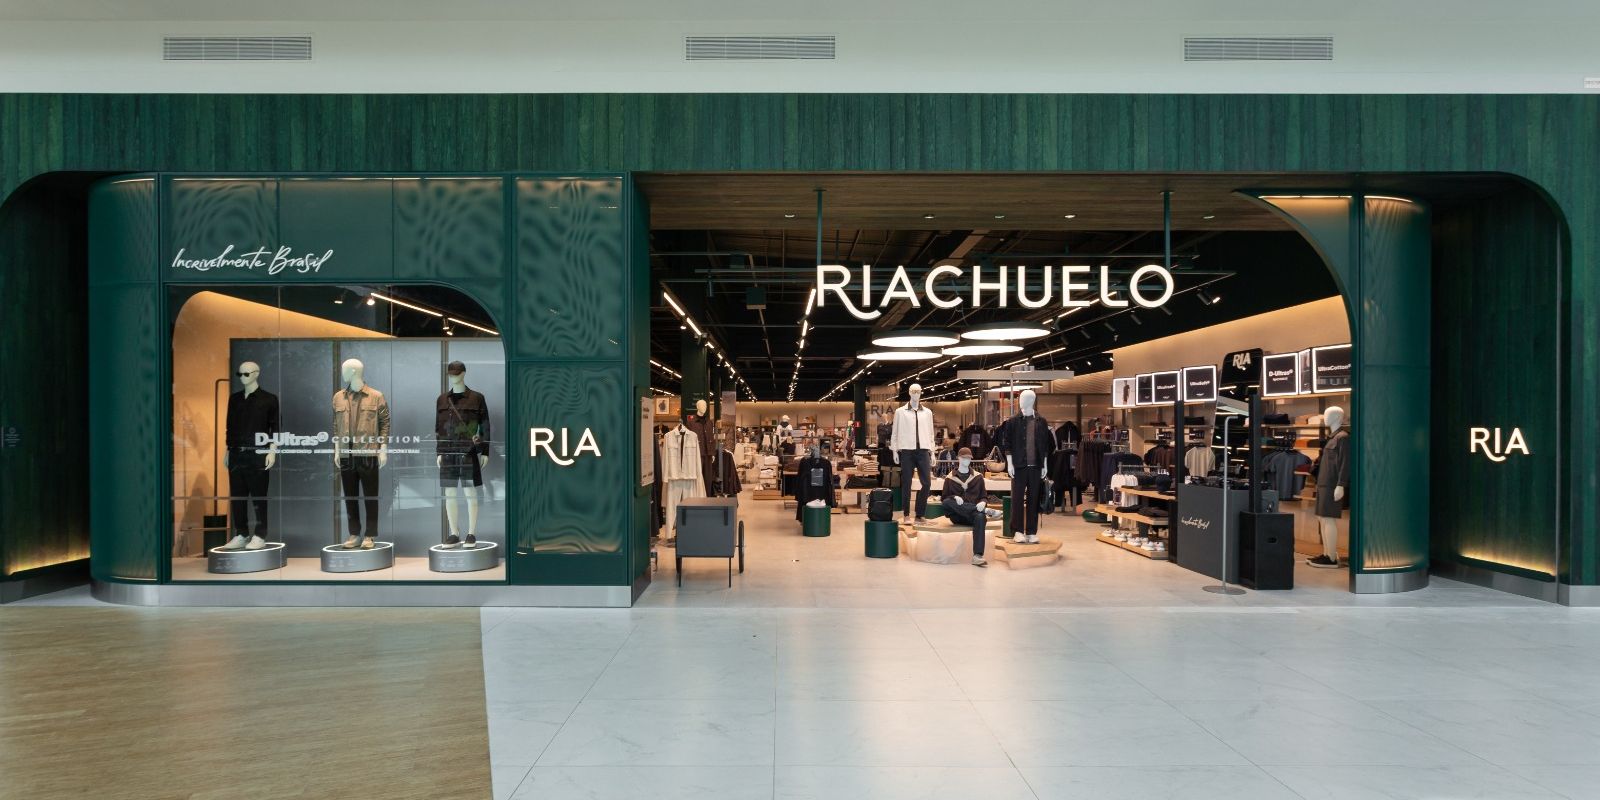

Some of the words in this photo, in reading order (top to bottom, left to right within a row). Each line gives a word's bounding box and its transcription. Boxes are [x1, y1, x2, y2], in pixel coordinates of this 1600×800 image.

[268, 245, 334, 275] Brasil
[815, 264, 1174, 321] RIACHUELO
[1232, 353, 1251, 370] RIA
[331, 435, 421, 444] COLLECTION
[530, 427, 602, 466] RIA
[1470, 427, 1530, 462] RIA
